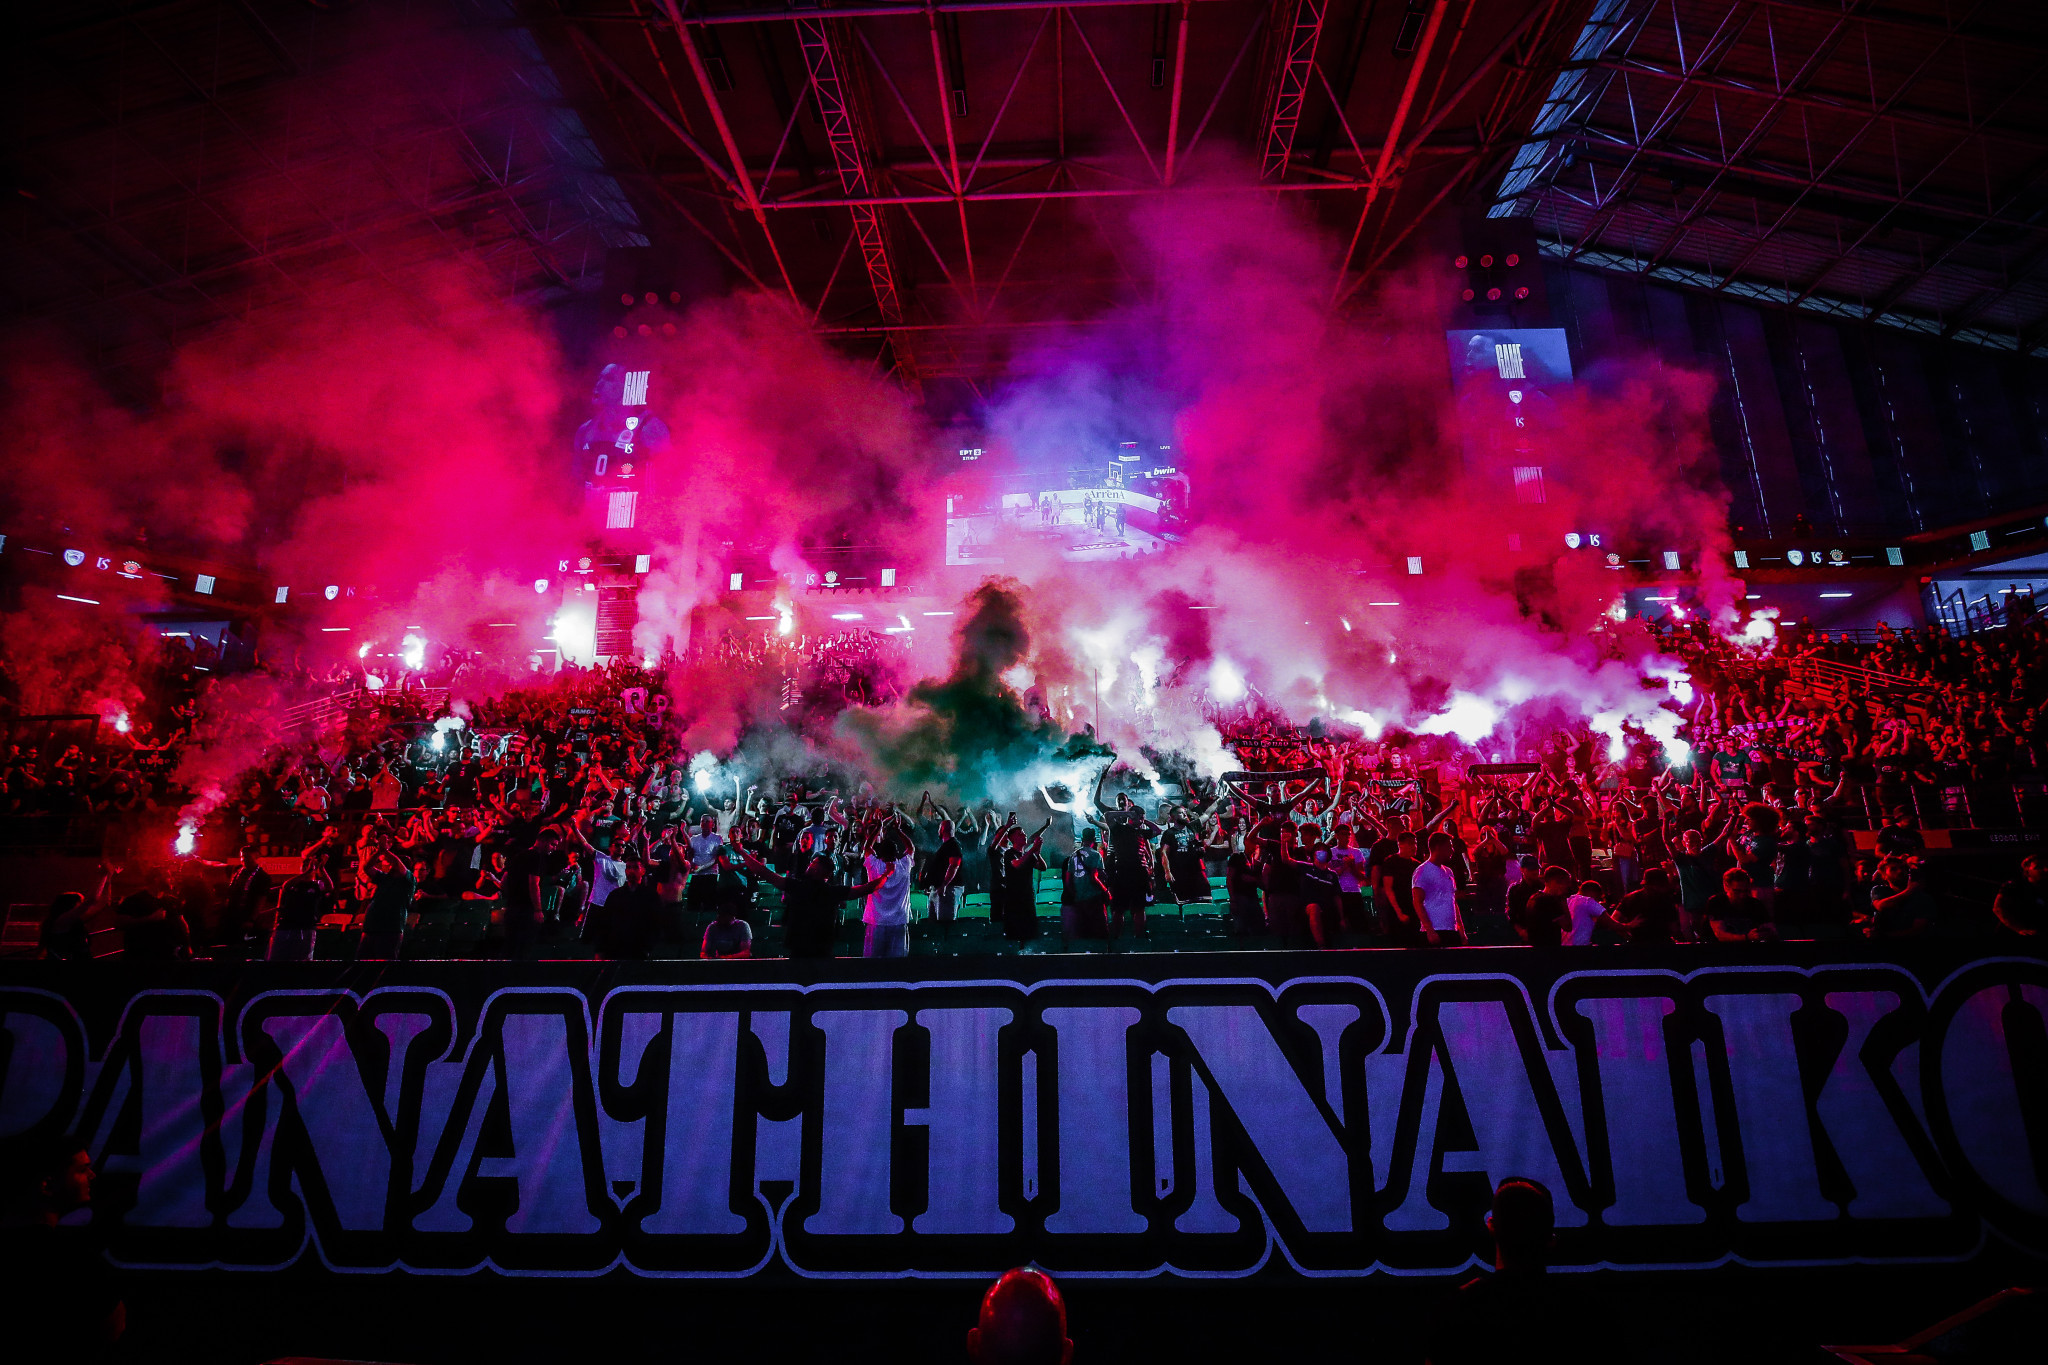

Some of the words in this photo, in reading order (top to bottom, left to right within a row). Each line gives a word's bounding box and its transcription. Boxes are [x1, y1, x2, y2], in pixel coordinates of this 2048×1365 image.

[1495, 344, 1526, 379] GAME
[622, 371, 650, 406] GAME
[1153, 466, 1176, 476] bwin
